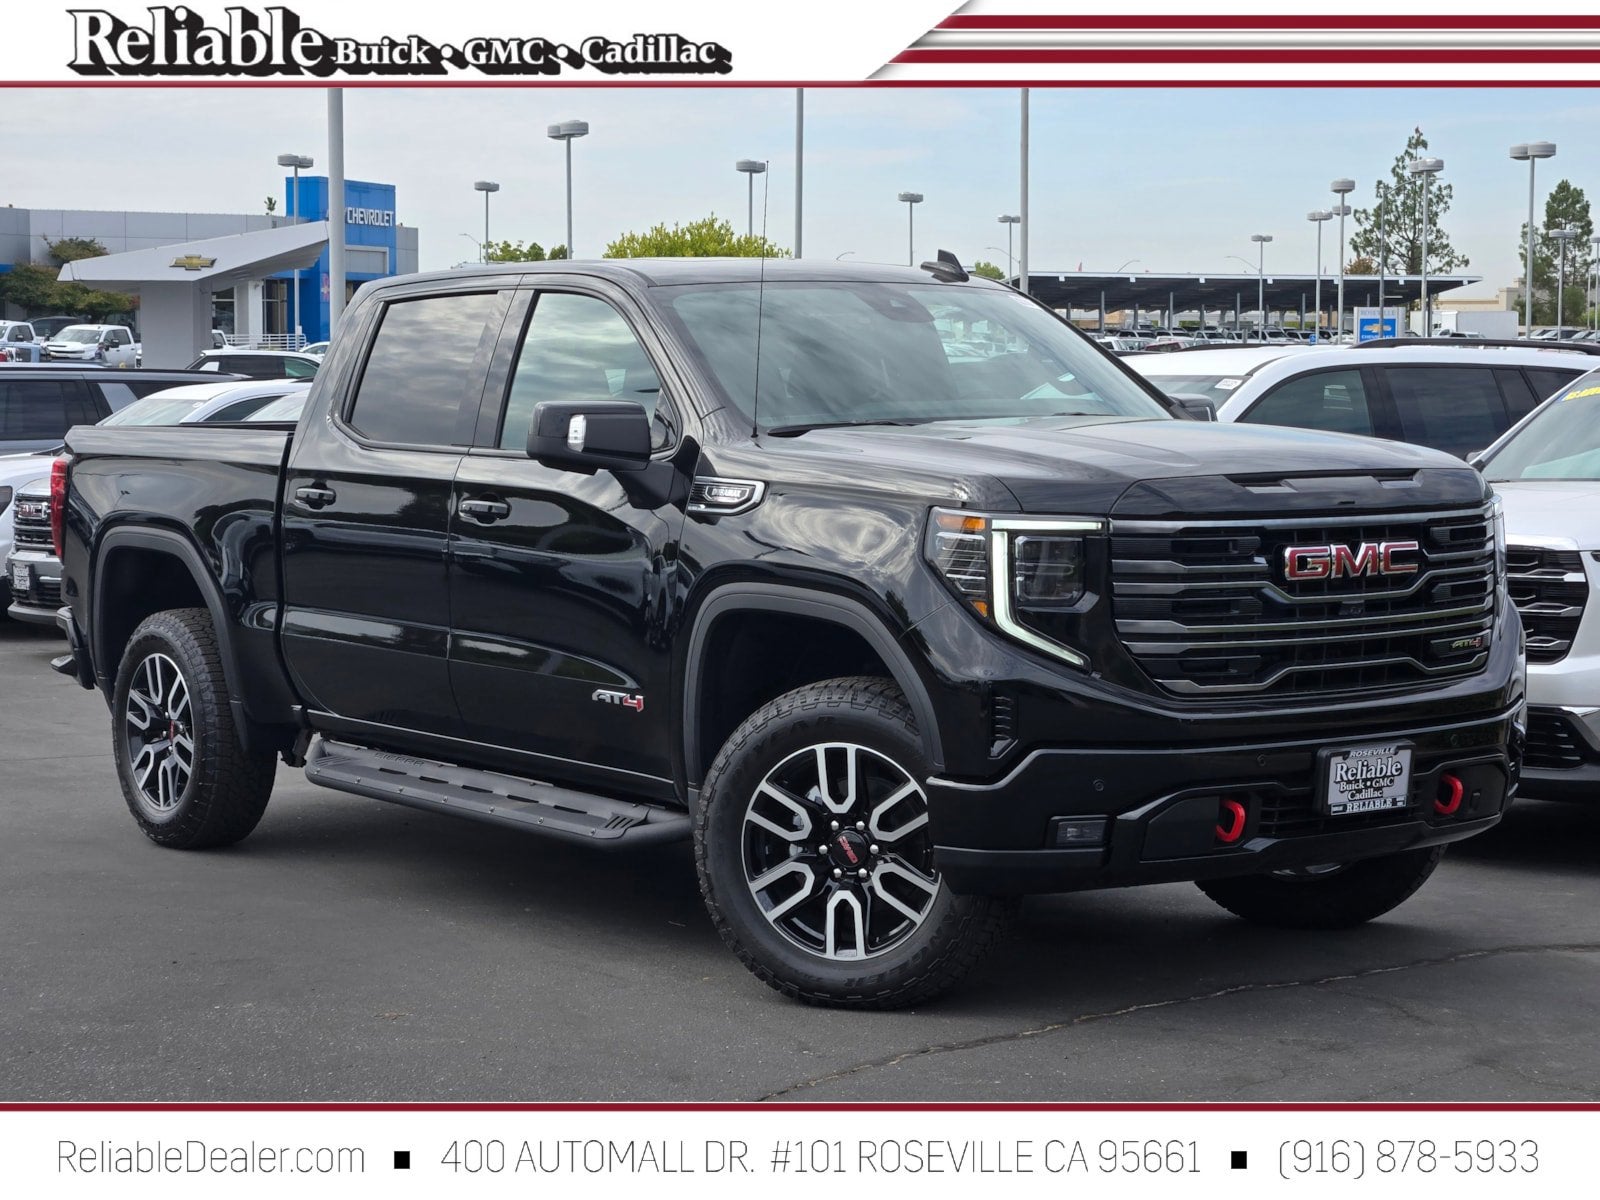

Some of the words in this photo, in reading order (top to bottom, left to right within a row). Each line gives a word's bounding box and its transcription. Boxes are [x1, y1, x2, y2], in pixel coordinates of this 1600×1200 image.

[347, 207, 394, 226] CHEVROLET
[1284, 541, 1419, 580] GMC
[1452, 637, 1482, 649] AT4
[591, 689, 645, 712] AT4
[1349, 748, 1396, 758] ROSEVILLE
[1334, 757, 1403, 783] Reliable
[1340, 781, 1366, 792] Buick
[1371, 776, 1395, 787] GMC
[1347, 789, 1384, 801] Cadillac
[1346, 798, 1393, 812] RELIABLE
